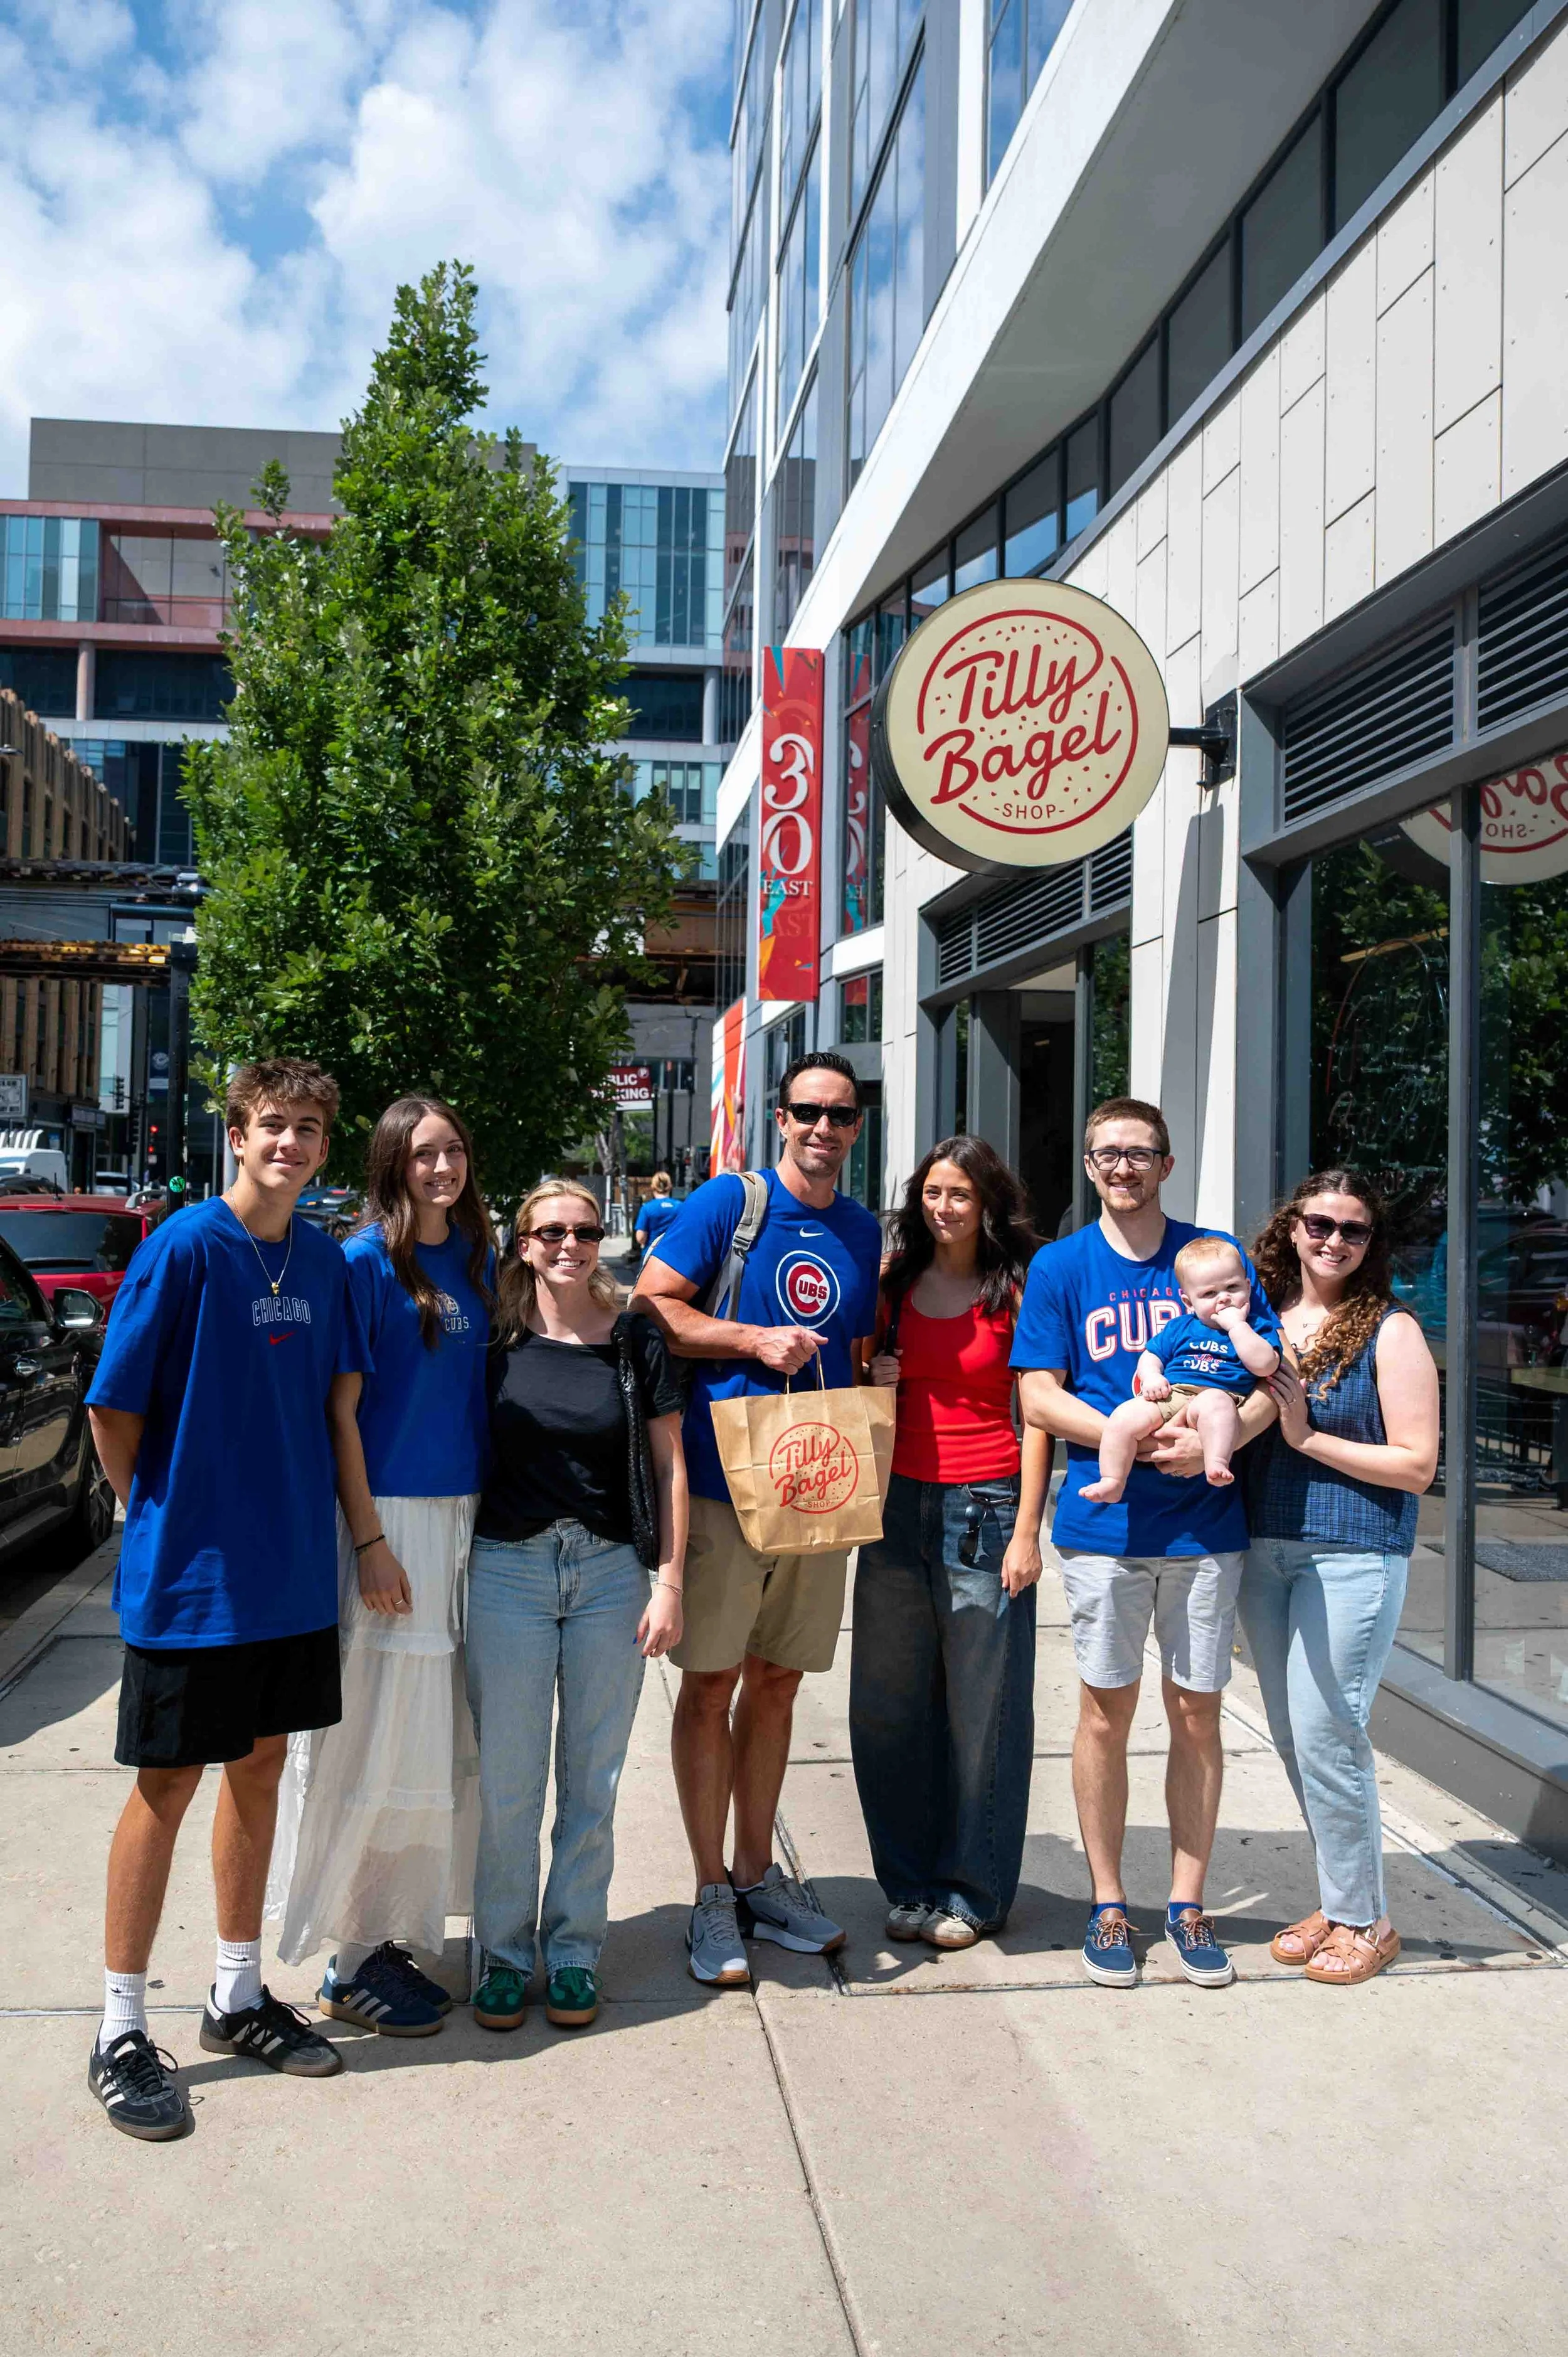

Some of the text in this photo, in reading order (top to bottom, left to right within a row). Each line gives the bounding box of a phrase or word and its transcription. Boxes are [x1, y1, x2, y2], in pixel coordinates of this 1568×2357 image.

[943, 644, 1080, 724] Tilly
[923, 690, 1122, 804] Bagel
[762, 733, 814, 875] 30
[763, 880, 813, 896] EAST
[252, 1297, 311, 1326] CHICAGO
[445, 1316, 469, 1331] CUBS
[1086, 1300, 1194, 1362] CUB
[1189, 1340, 1228, 1354] CUBS
[777, 1435, 831, 1472] Tilly
[774, 1450, 852, 1508] Bagel
